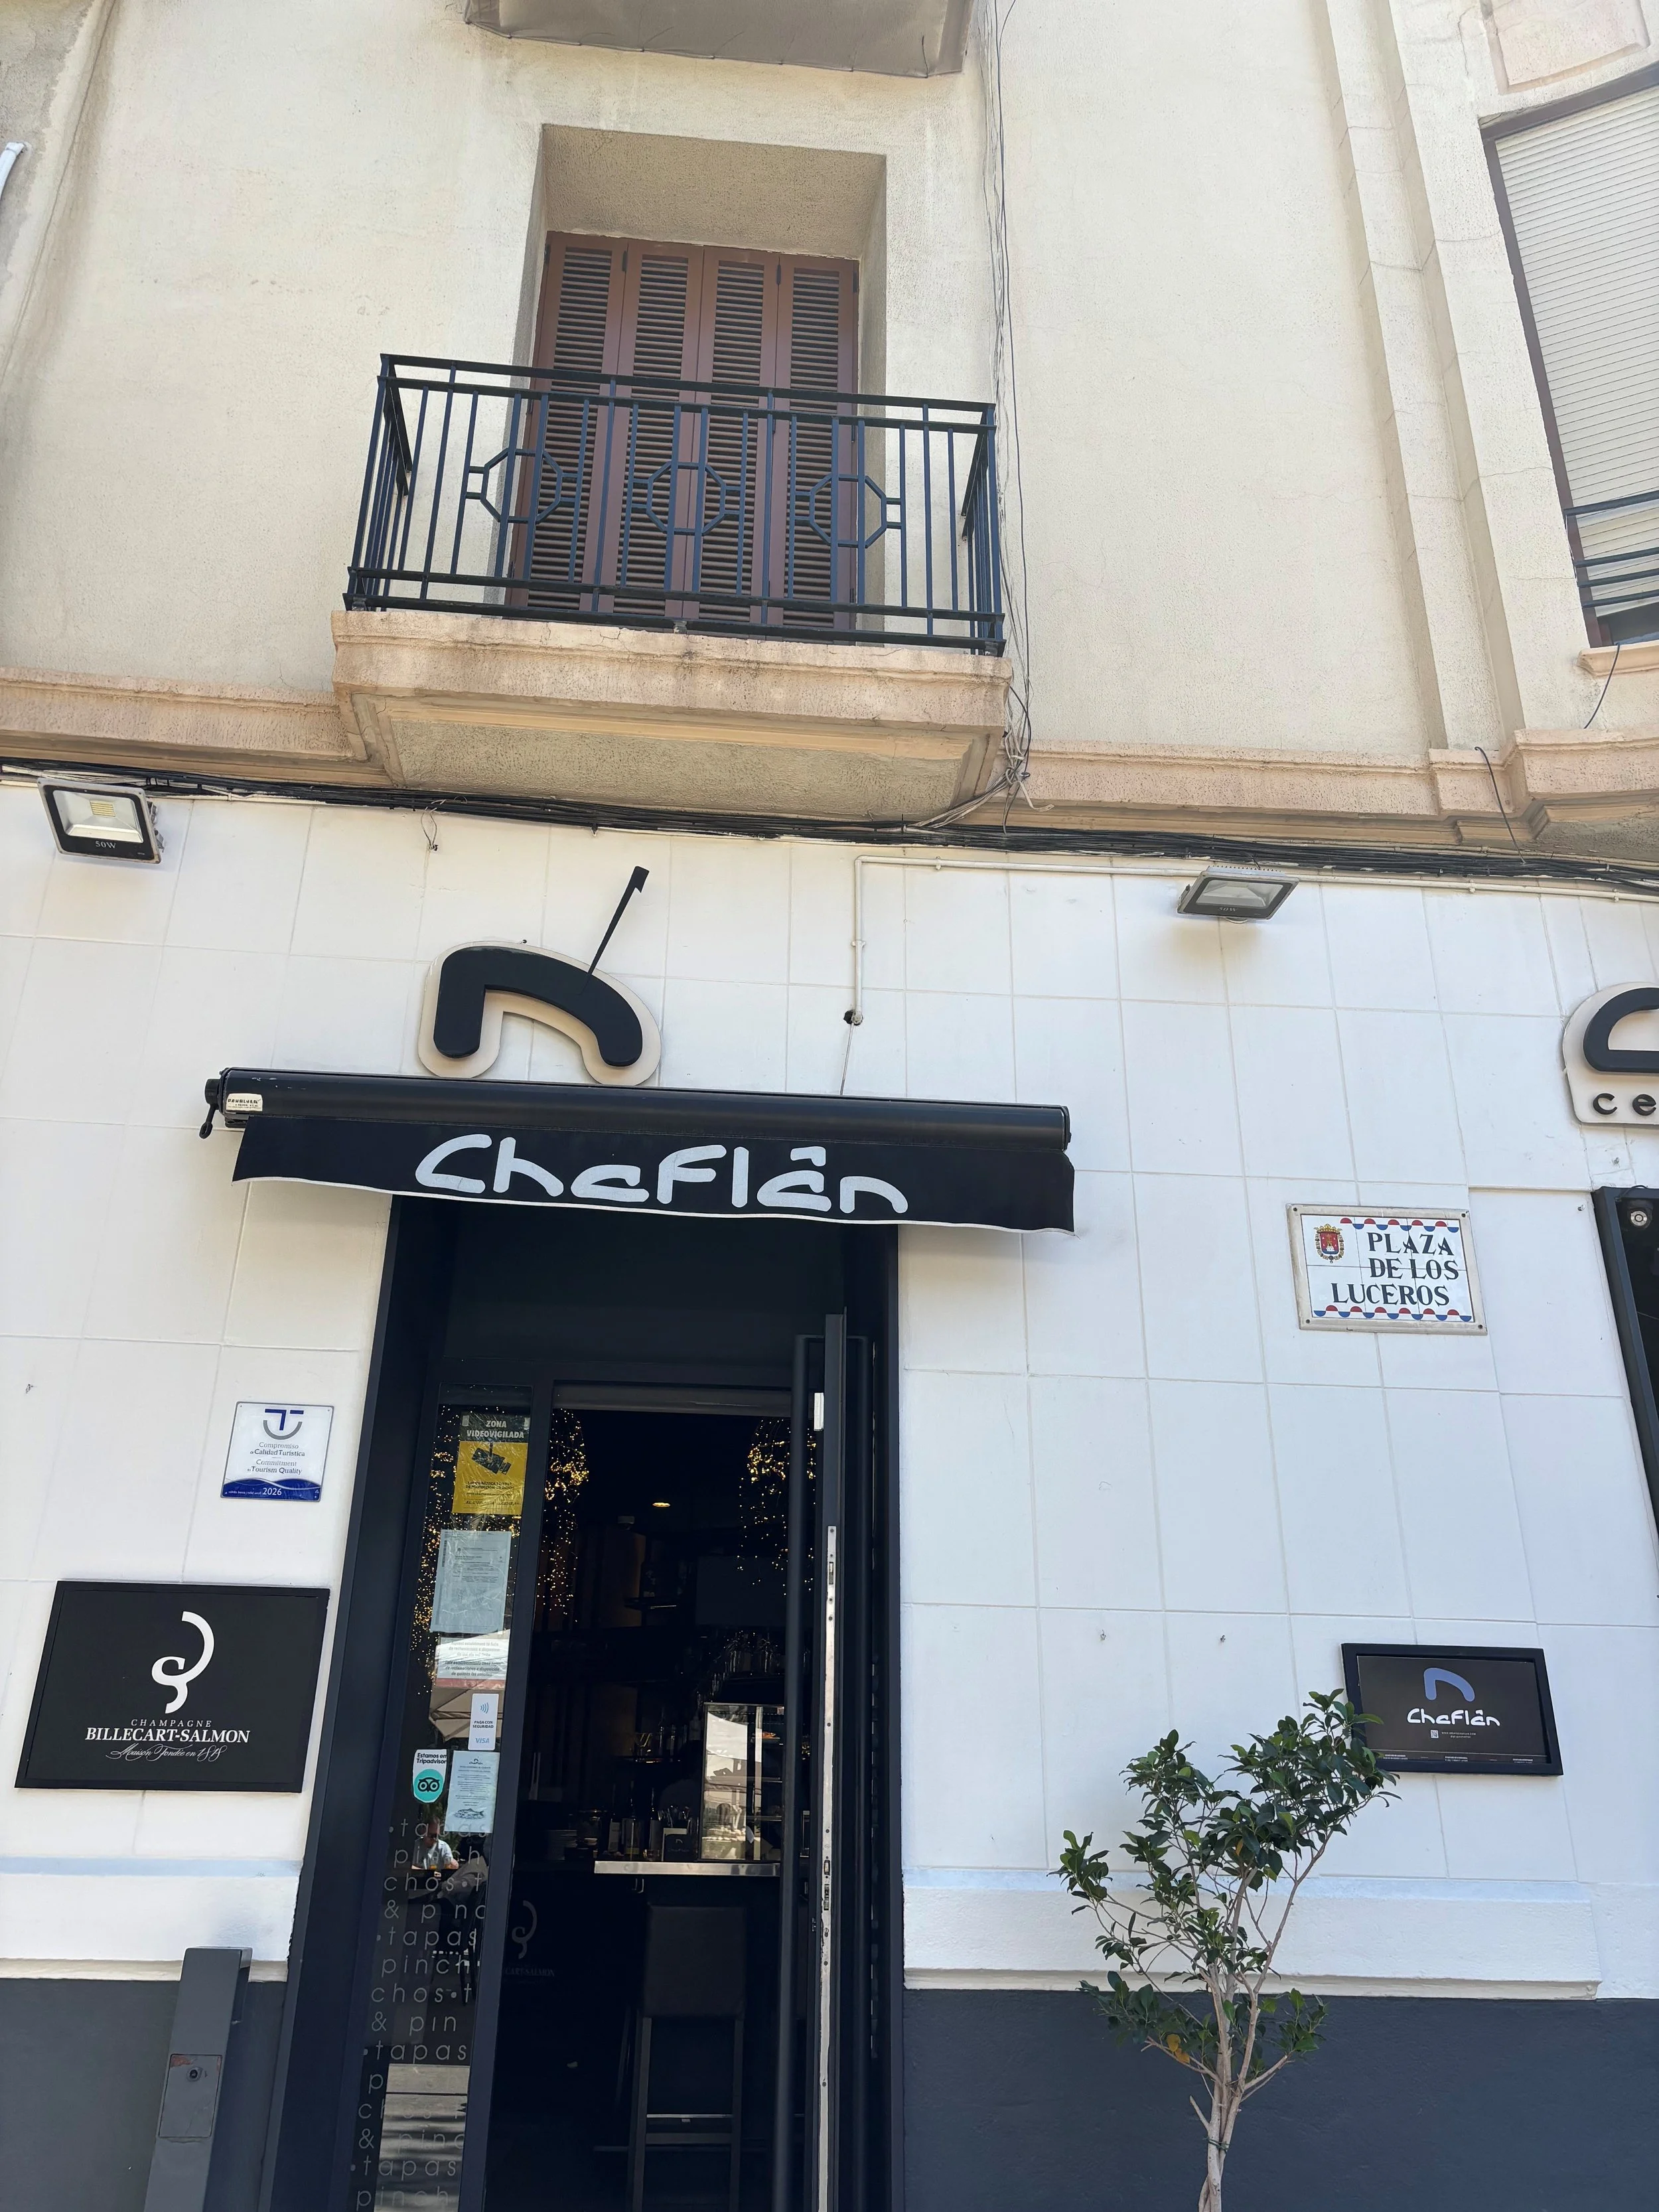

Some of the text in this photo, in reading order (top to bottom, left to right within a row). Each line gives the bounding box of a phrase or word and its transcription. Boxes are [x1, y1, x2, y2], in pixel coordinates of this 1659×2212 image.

[95, 840, 116, 849] 50W
[1366, 1232, 1455, 1256] PLAZA
[1368, 1258, 1459, 1280] DE LOS
[1331, 1282, 1450, 1307] LUCEROS
[485, 1420, 507, 1428] ZONA
[467, 1430, 524, 1439] VIDEOVIGILADA
[131, 1719, 212, 1728] CHAMPAGNE
[85, 1727, 251, 1743] BILLECART-SALMON
[106, 1743, 153, 1761] Maison
[146, 1744, 193, 1761] Fondée
[196, 1745, 228, 1762] 1818
[382, 1954, 470, 1978] pinch
